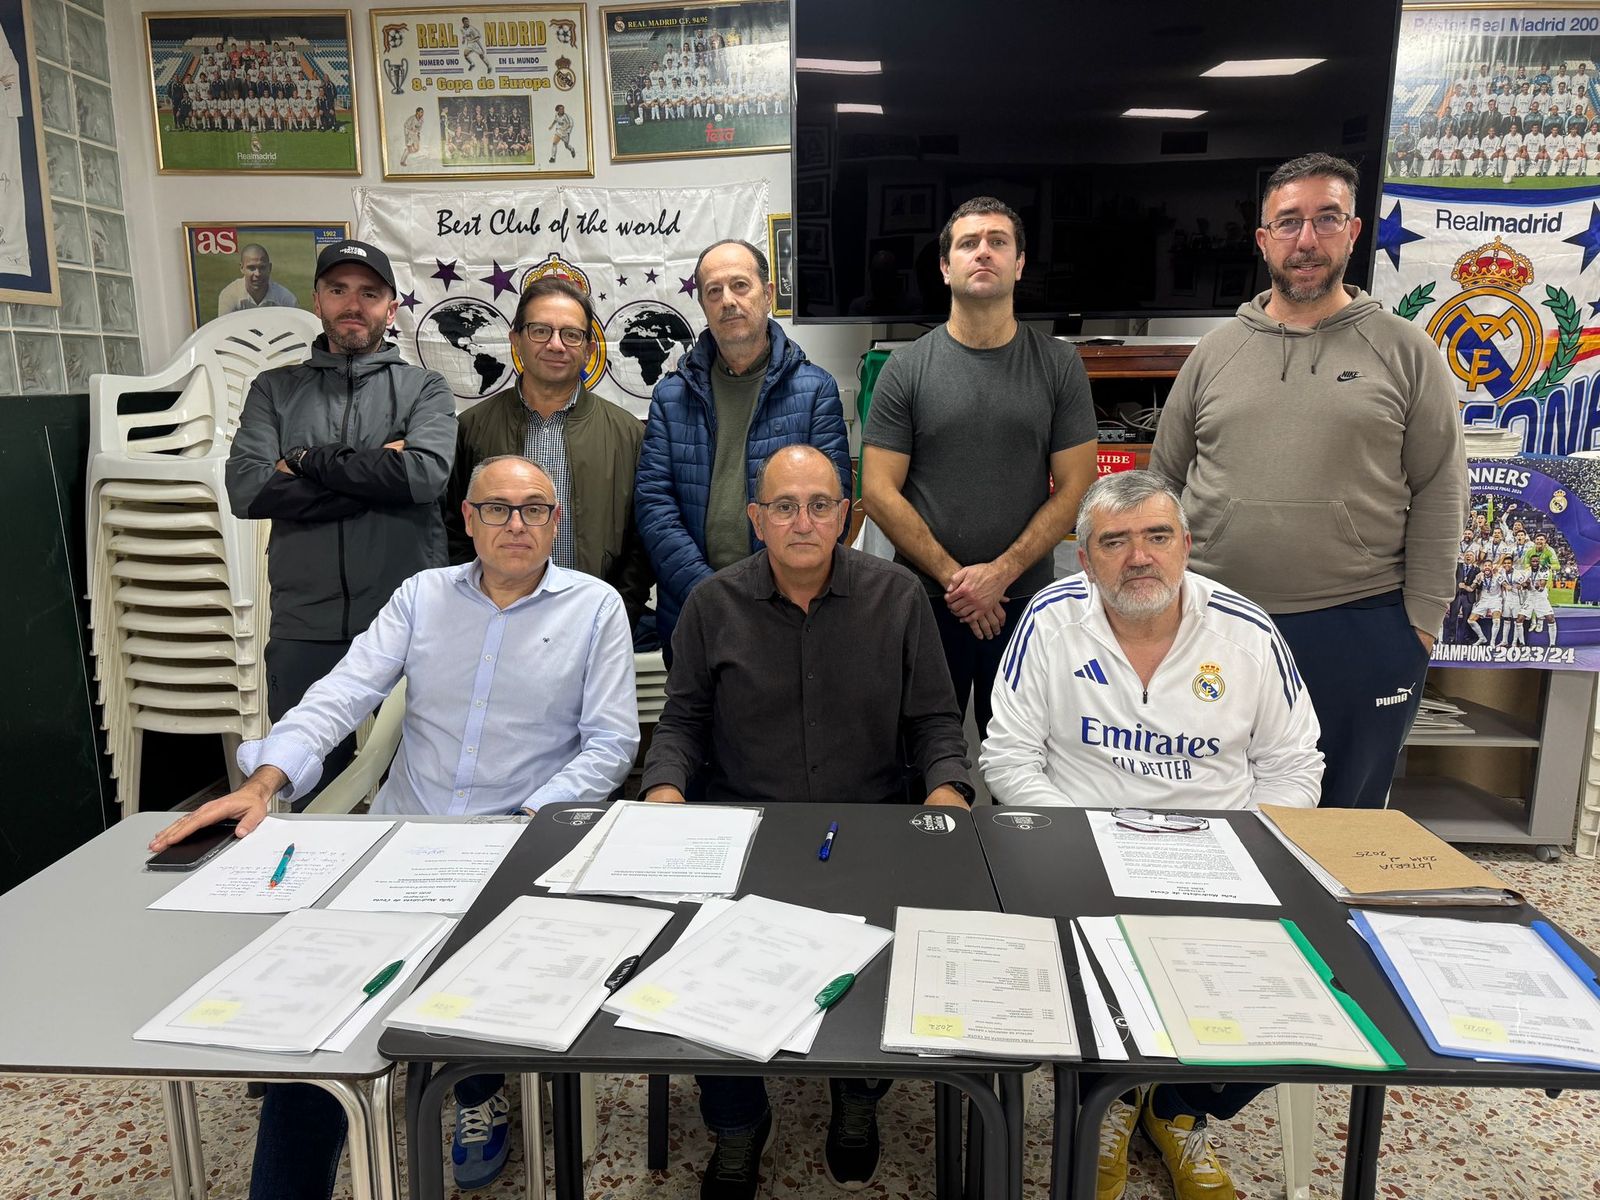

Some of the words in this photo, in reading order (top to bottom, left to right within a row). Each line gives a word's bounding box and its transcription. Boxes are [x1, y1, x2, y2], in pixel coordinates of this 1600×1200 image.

[627, 20, 648, 29] REAL
[648, 18, 677, 27] MADRID
[1470, 17, 1505, 32] Real
[1510, 17, 1565, 32] Madrid
[416, 23, 459, 49] REAL
[484, 20, 547, 47] MADRID
[445, 58, 459, 66] UNO
[498, 57, 507, 65] EN
[436, 77, 473, 93] Copa
[477, 76, 495, 90] de
[499, 75, 551, 91] Europa
[436, 208, 482, 238] Best
[489, 207, 541, 237] Club
[547, 208, 571, 244] of
[576, 208, 608, 235] the
[616, 208, 682, 238] world
[1436, 208, 1563, 234] Realmadrid
[197, 230, 237, 254] as
[1341, 370, 1360, 378] NIKE
[1494, 646, 1575, 664] 2023/24
[1375, 692, 1408, 707] PUMA
[1080, 715, 1221, 759] Emirates
[1140, 759, 1192, 780] BETTER
